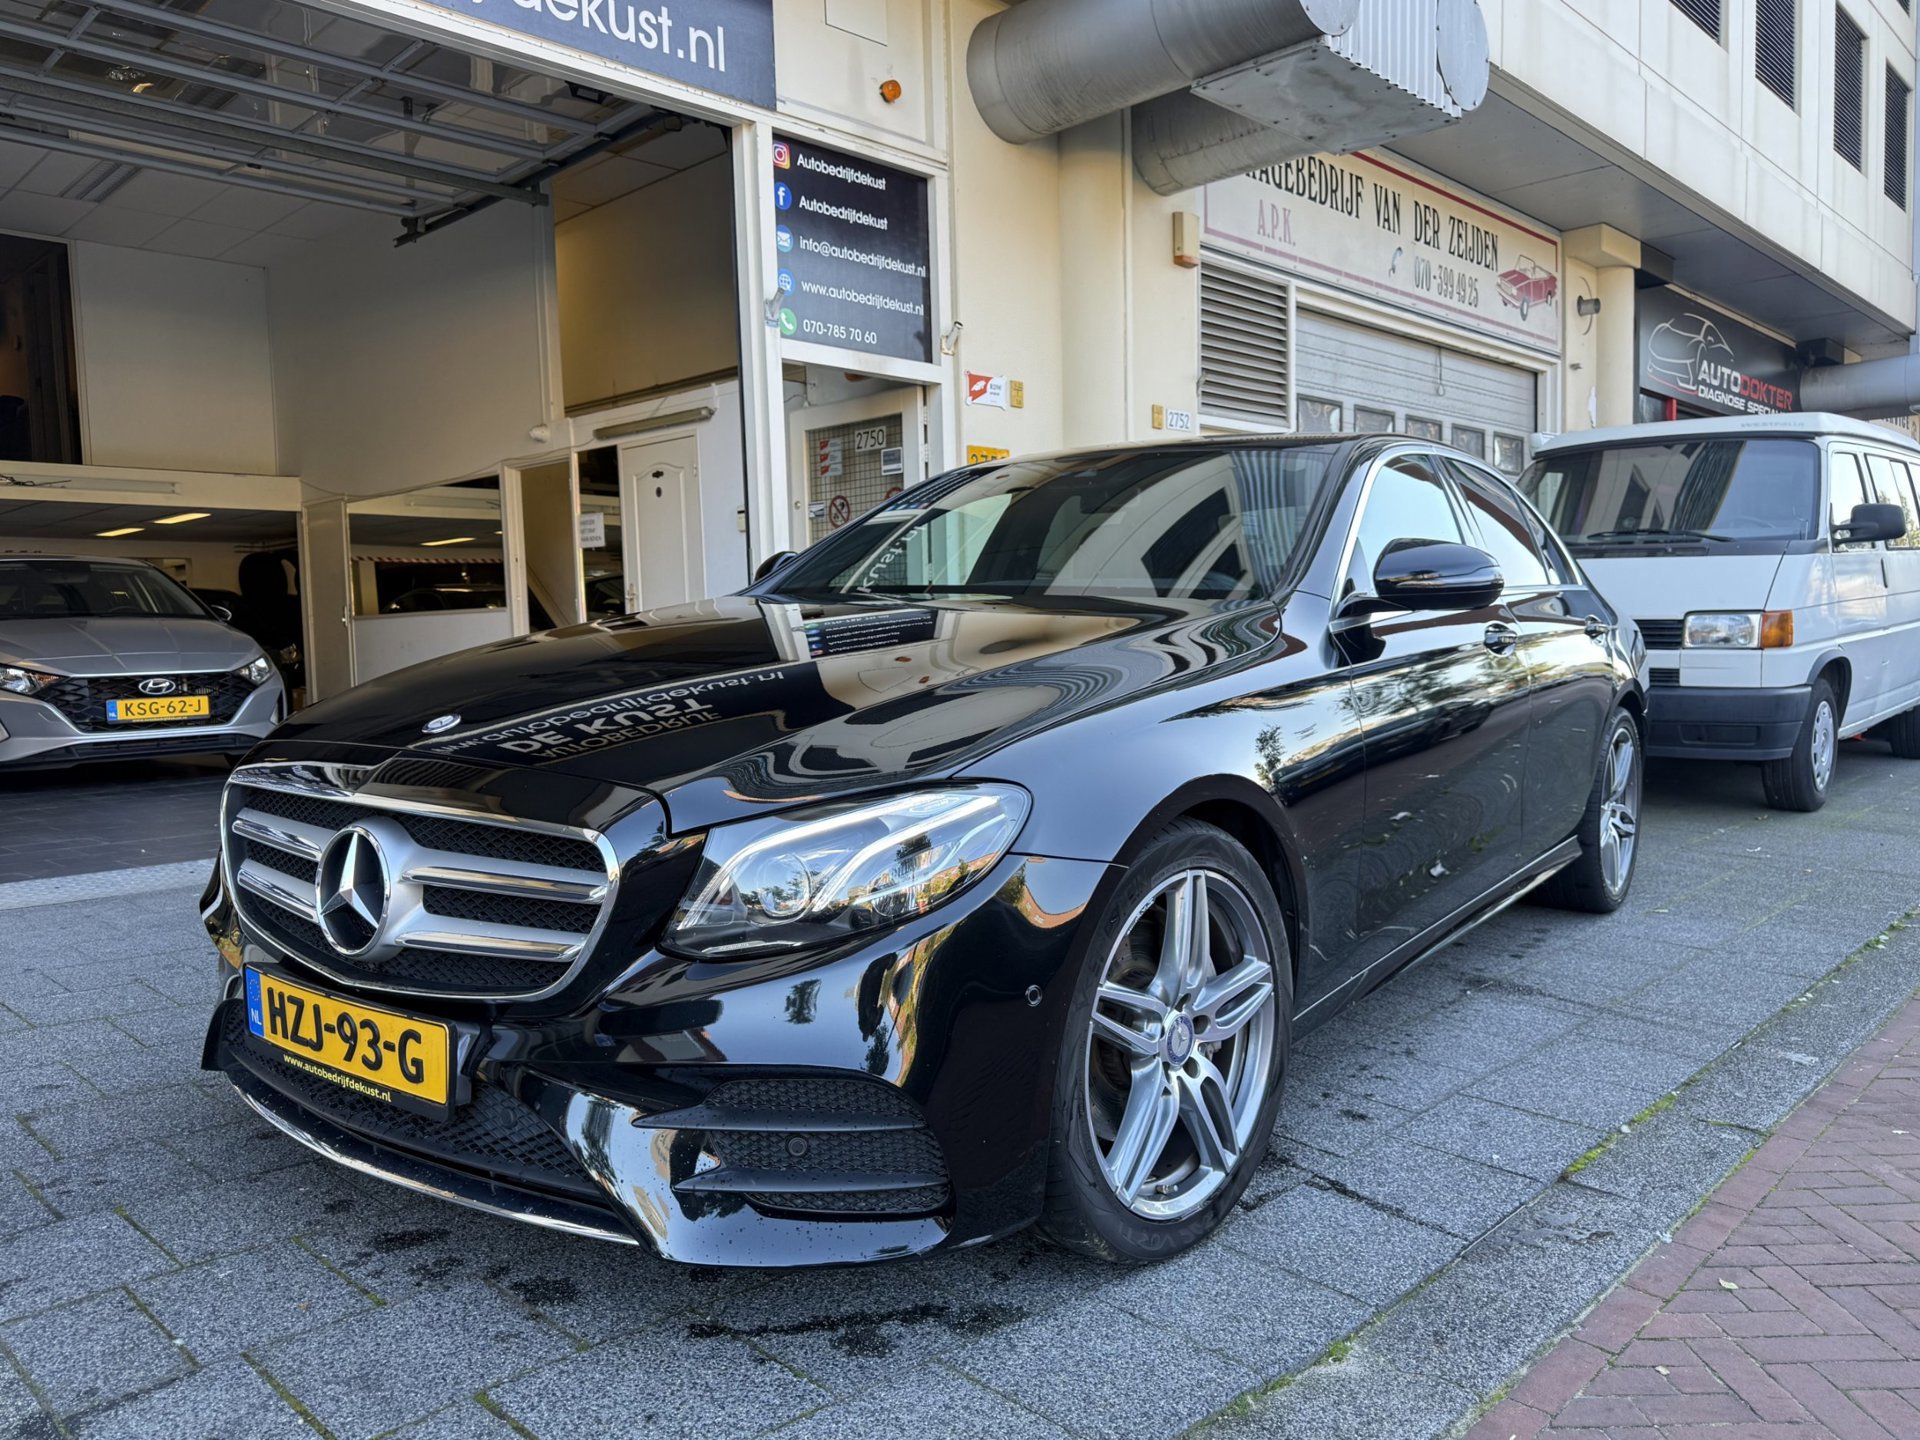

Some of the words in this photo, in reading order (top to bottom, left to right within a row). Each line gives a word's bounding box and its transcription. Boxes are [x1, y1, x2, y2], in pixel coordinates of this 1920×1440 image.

[797, 154, 887, 191] Autobedrijfdekust
[799, 195, 889, 231] Autobedrijfdekust
[1257, 199, 1296, 246] A.P.K.
[1373, 183, 1401, 235] VAN
[1414, 200, 1440, 250] DER
[1448, 215, 1498, 272] ZEIJDEN
[799, 235, 926, 277] info@autobedrijfdekust.nl
[801, 281, 925, 316] www.autobedrijfdekust.nl
[803, 319, 847, 339] 070-785
[850, 327, 862, 342] 70
[864, 331, 878, 345] 60
[1698, 385, 1746, 410] DIAGNOSE
[1168, 411, 1190, 429] 2752
[856, 428, 885, 450] 2750
[125, 699, 202, 717] KSG-62-J
[251, 1007, 262, 1026] NL
[267, 986, 424, 1084] HZJ-93-G
[283, 1053, 391, 1103] www.autobedrijfdekust.nl
